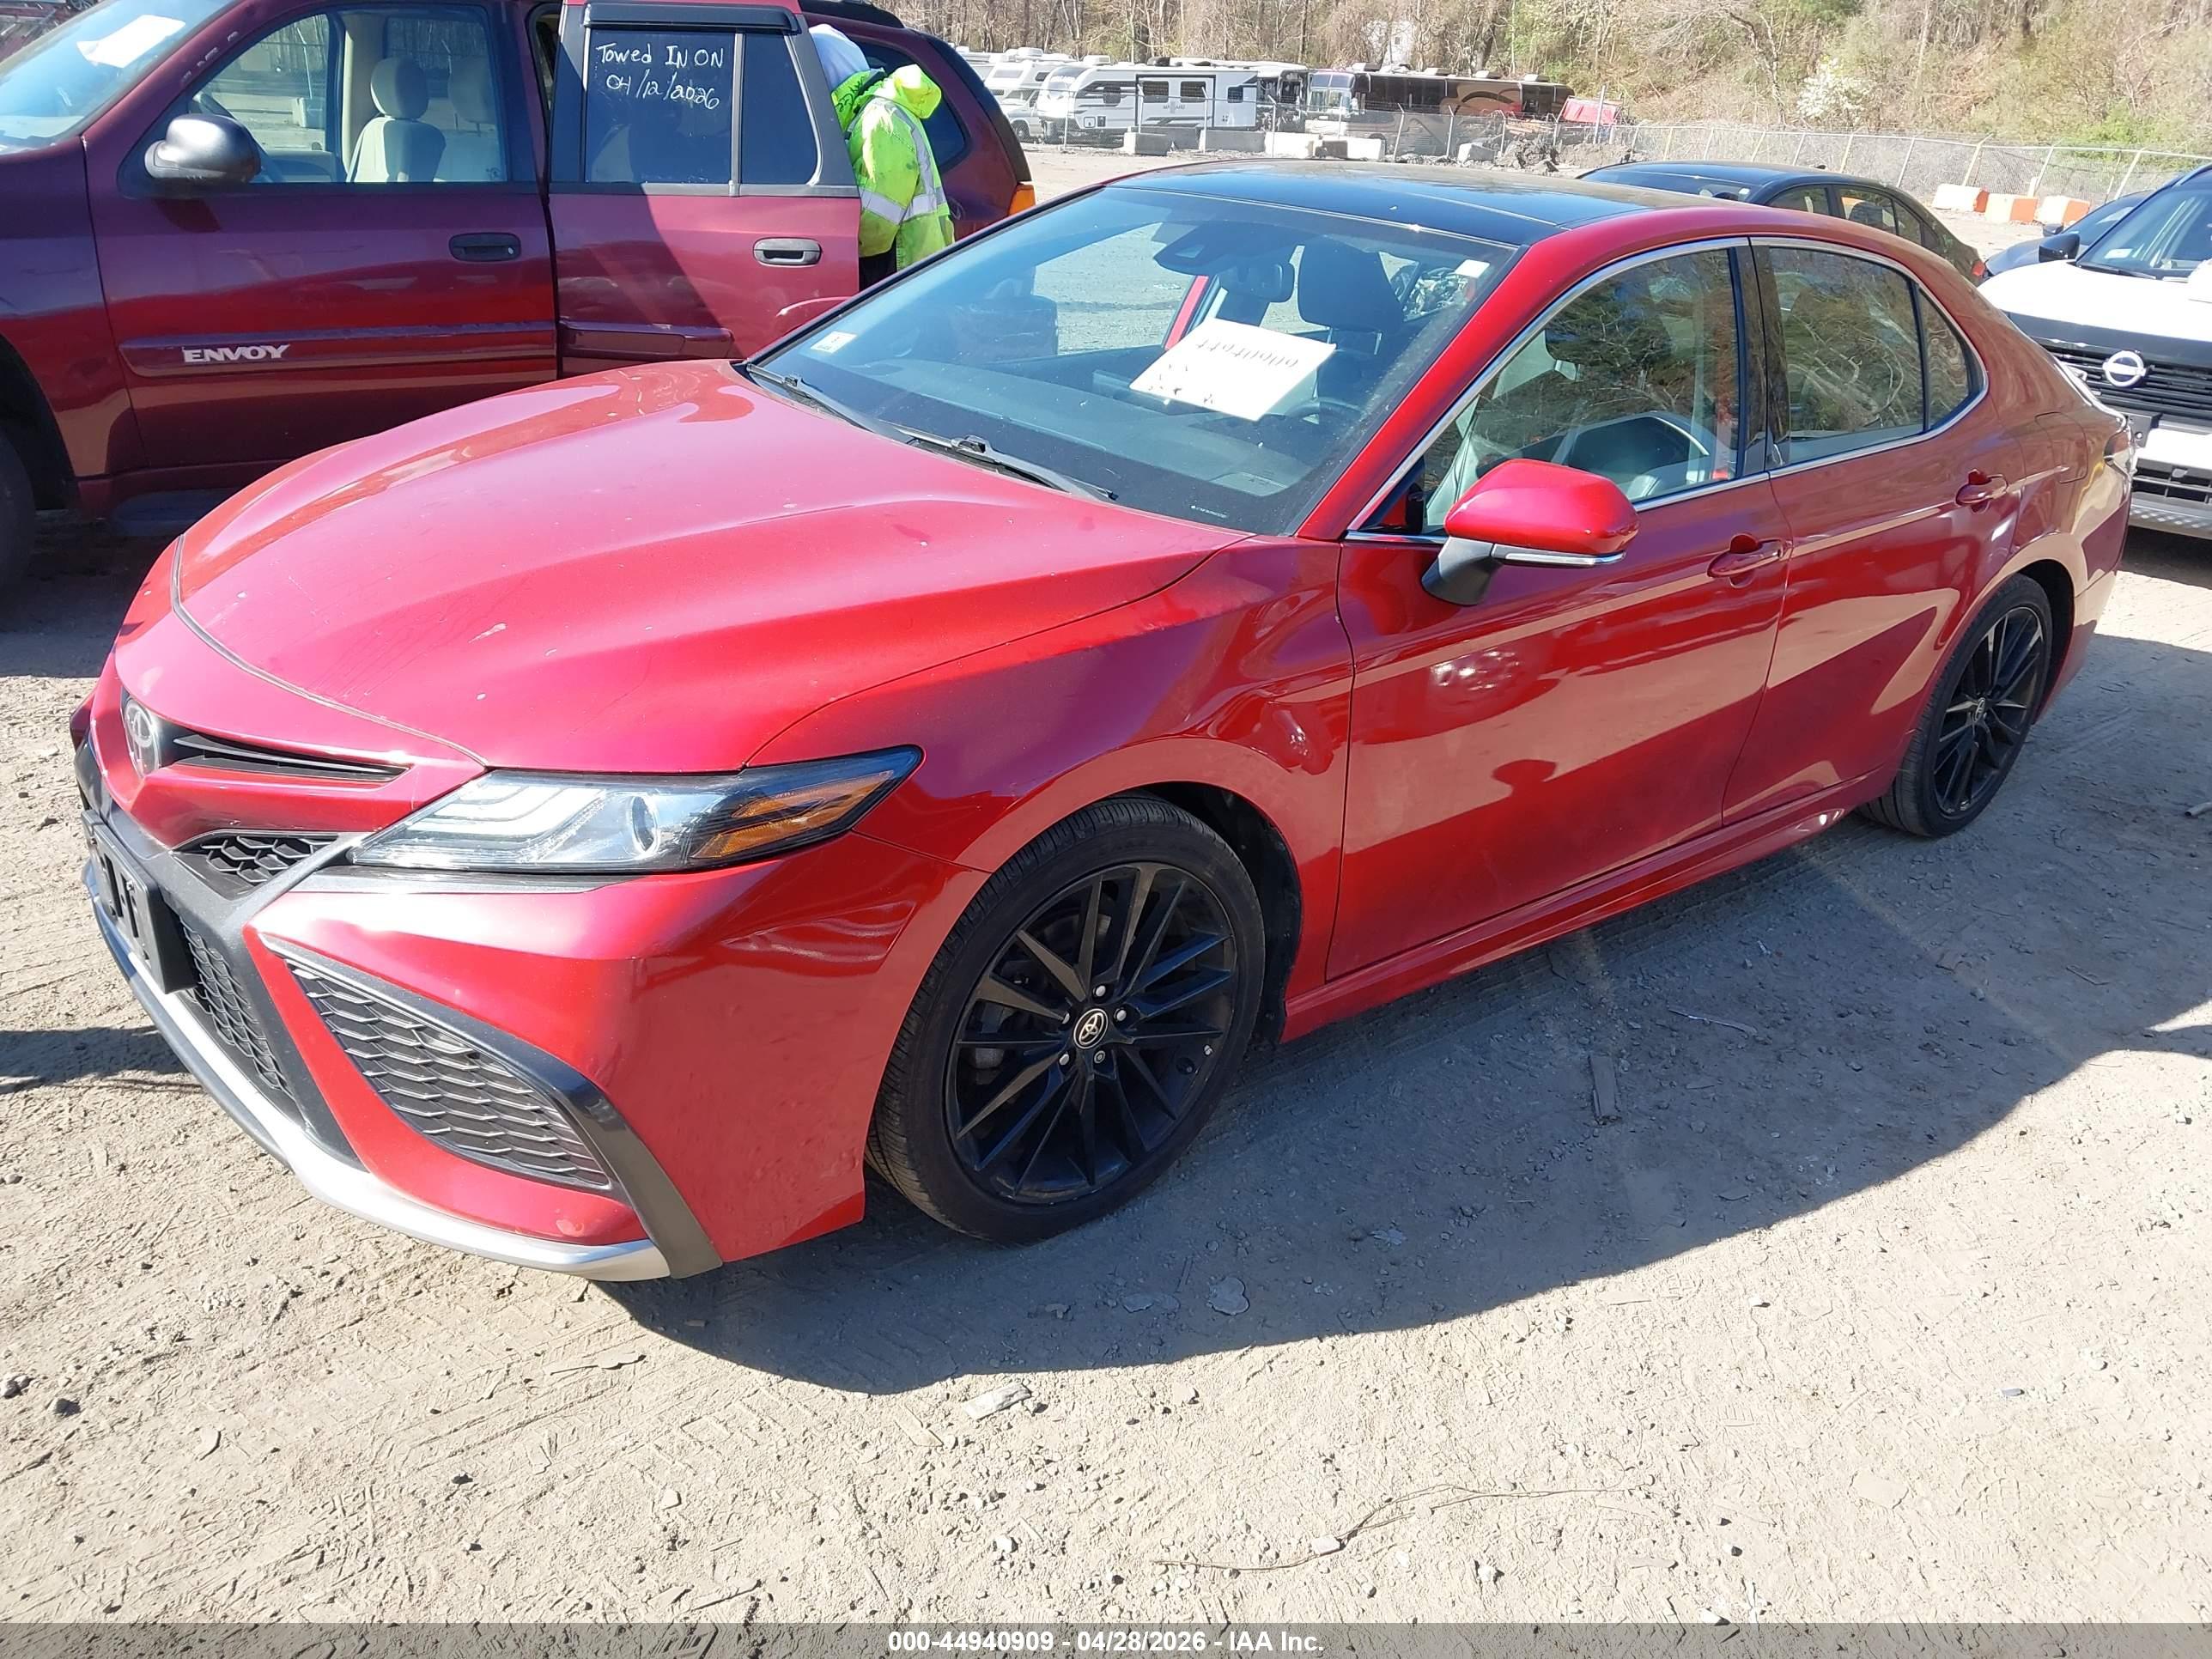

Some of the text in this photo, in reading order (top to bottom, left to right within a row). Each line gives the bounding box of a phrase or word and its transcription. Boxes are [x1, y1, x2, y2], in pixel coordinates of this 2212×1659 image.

[595, 43, 723, 68] Towed IN ON
[181, 344, 290, 362] ENVOY
